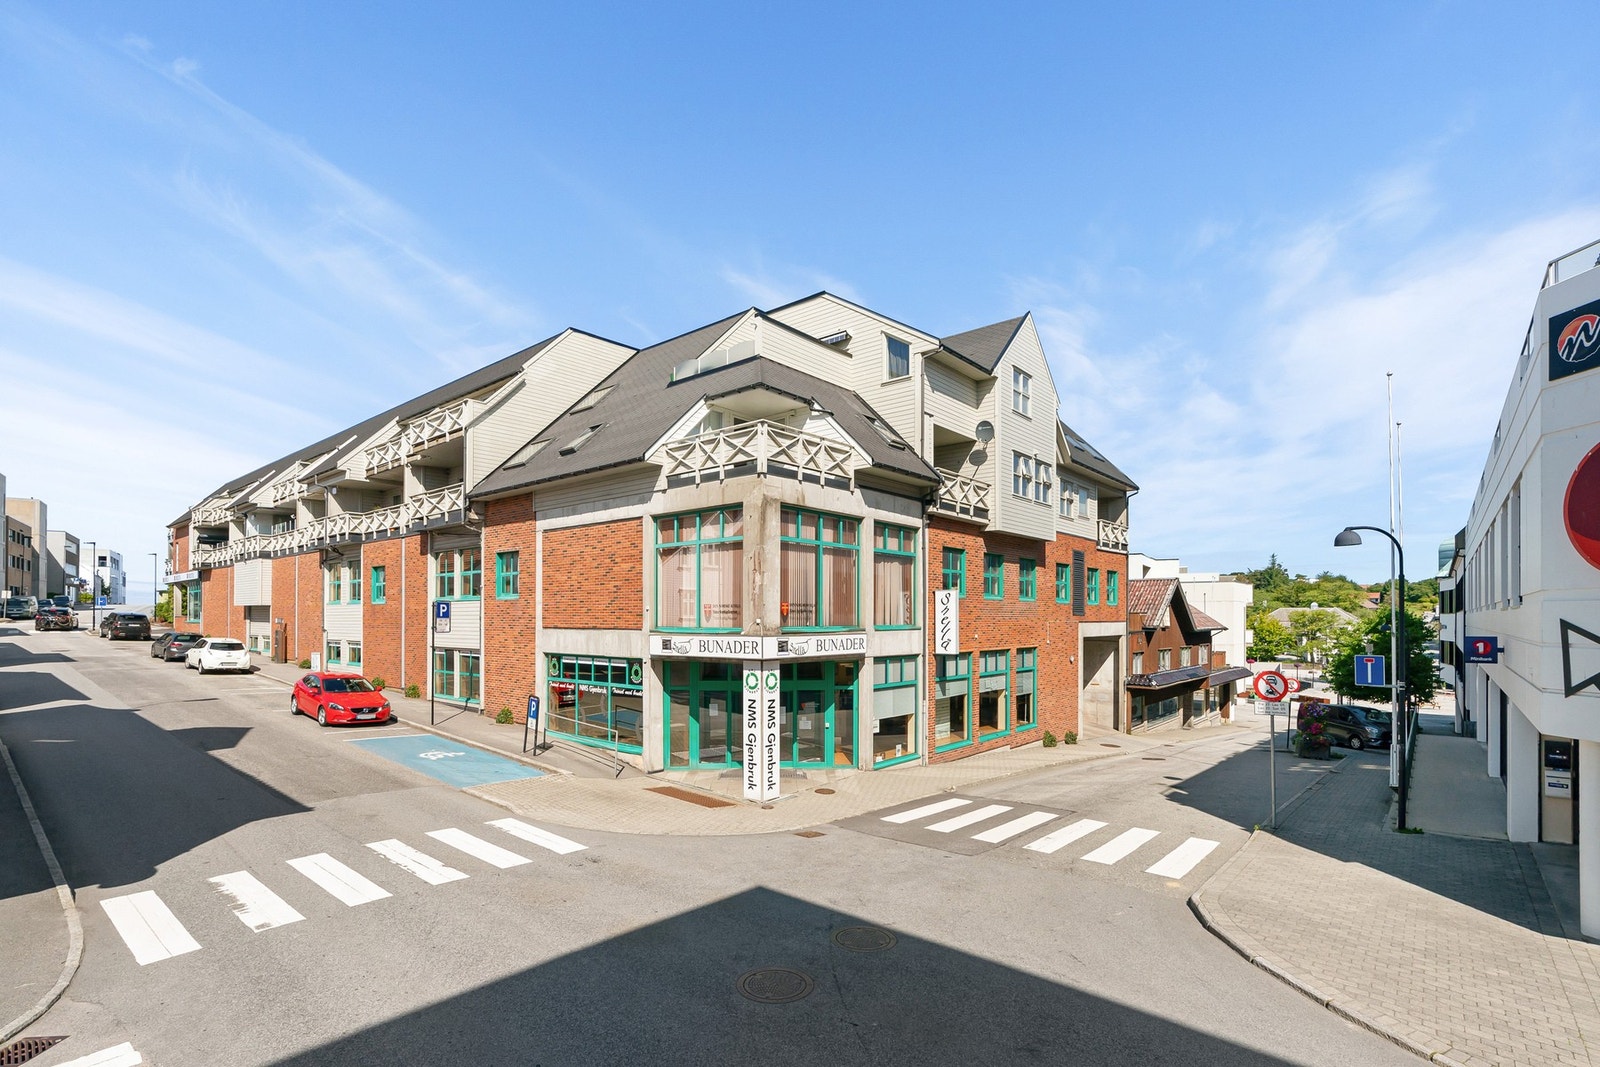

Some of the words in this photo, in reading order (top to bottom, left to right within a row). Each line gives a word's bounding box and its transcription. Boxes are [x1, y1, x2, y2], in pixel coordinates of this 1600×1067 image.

[440, 604, 448, 616] P
[698, 639, 760, 655] BUNADER
[816, 638, 866, 652] BUNADER
[530, 701, 536, 716] P
[747, 698, 756, 729] NMS
[767, 698, 776, 729] NMS
[745, 733, 757, 791] Gjenbruk
[765, 733, 776, 791] Gjenbruk
